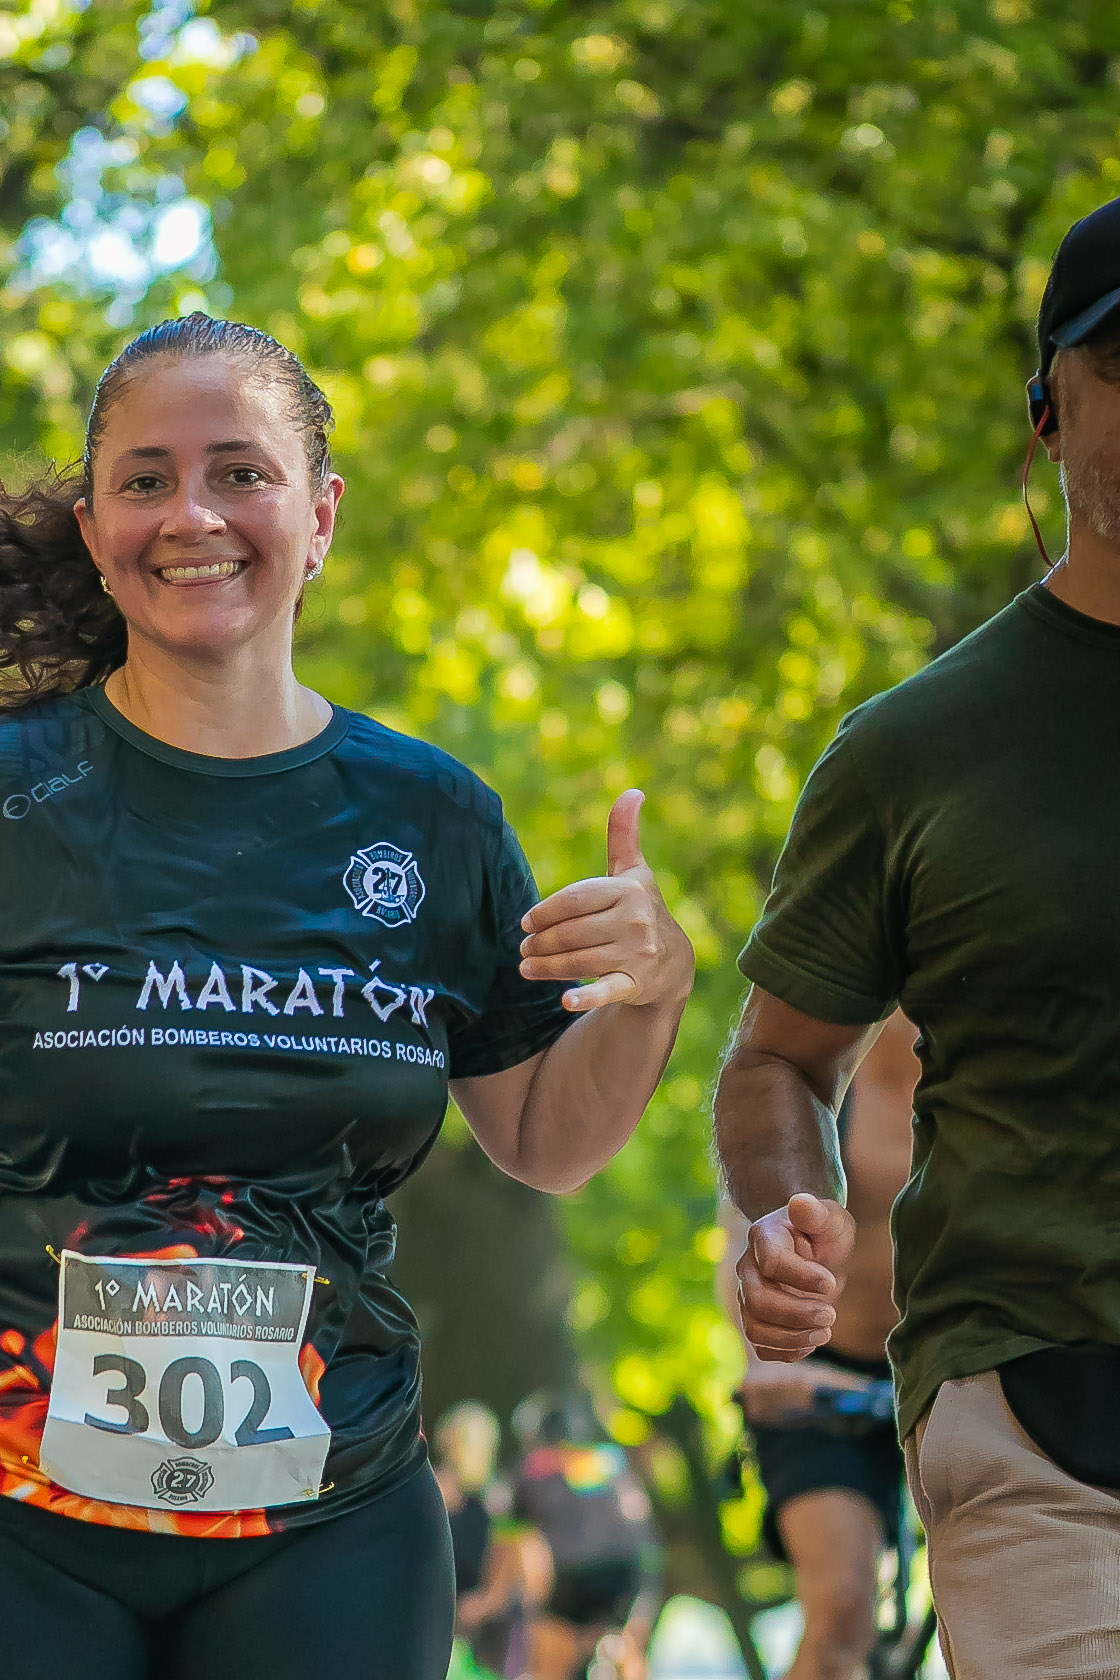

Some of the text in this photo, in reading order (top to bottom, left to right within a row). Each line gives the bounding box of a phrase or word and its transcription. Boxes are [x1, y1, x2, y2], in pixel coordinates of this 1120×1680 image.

[371, 866, 404, 896] 27
[135, 958, 435, 1029] MARATÓN
[32, 1024, 445, 1070] ASOCIACIÓN BOMBEROS VOLUNTARIOS ROSARO
[131, 1273, 275, 1317] MARATÓN
[73, 1313, 295, 1341] ASOCIACIÓN BOMBEROS VOLUNTARIOS ROSARIO
[83, 1353, 296, 1450] 302
[170, 1470, 197, 1488] 27
